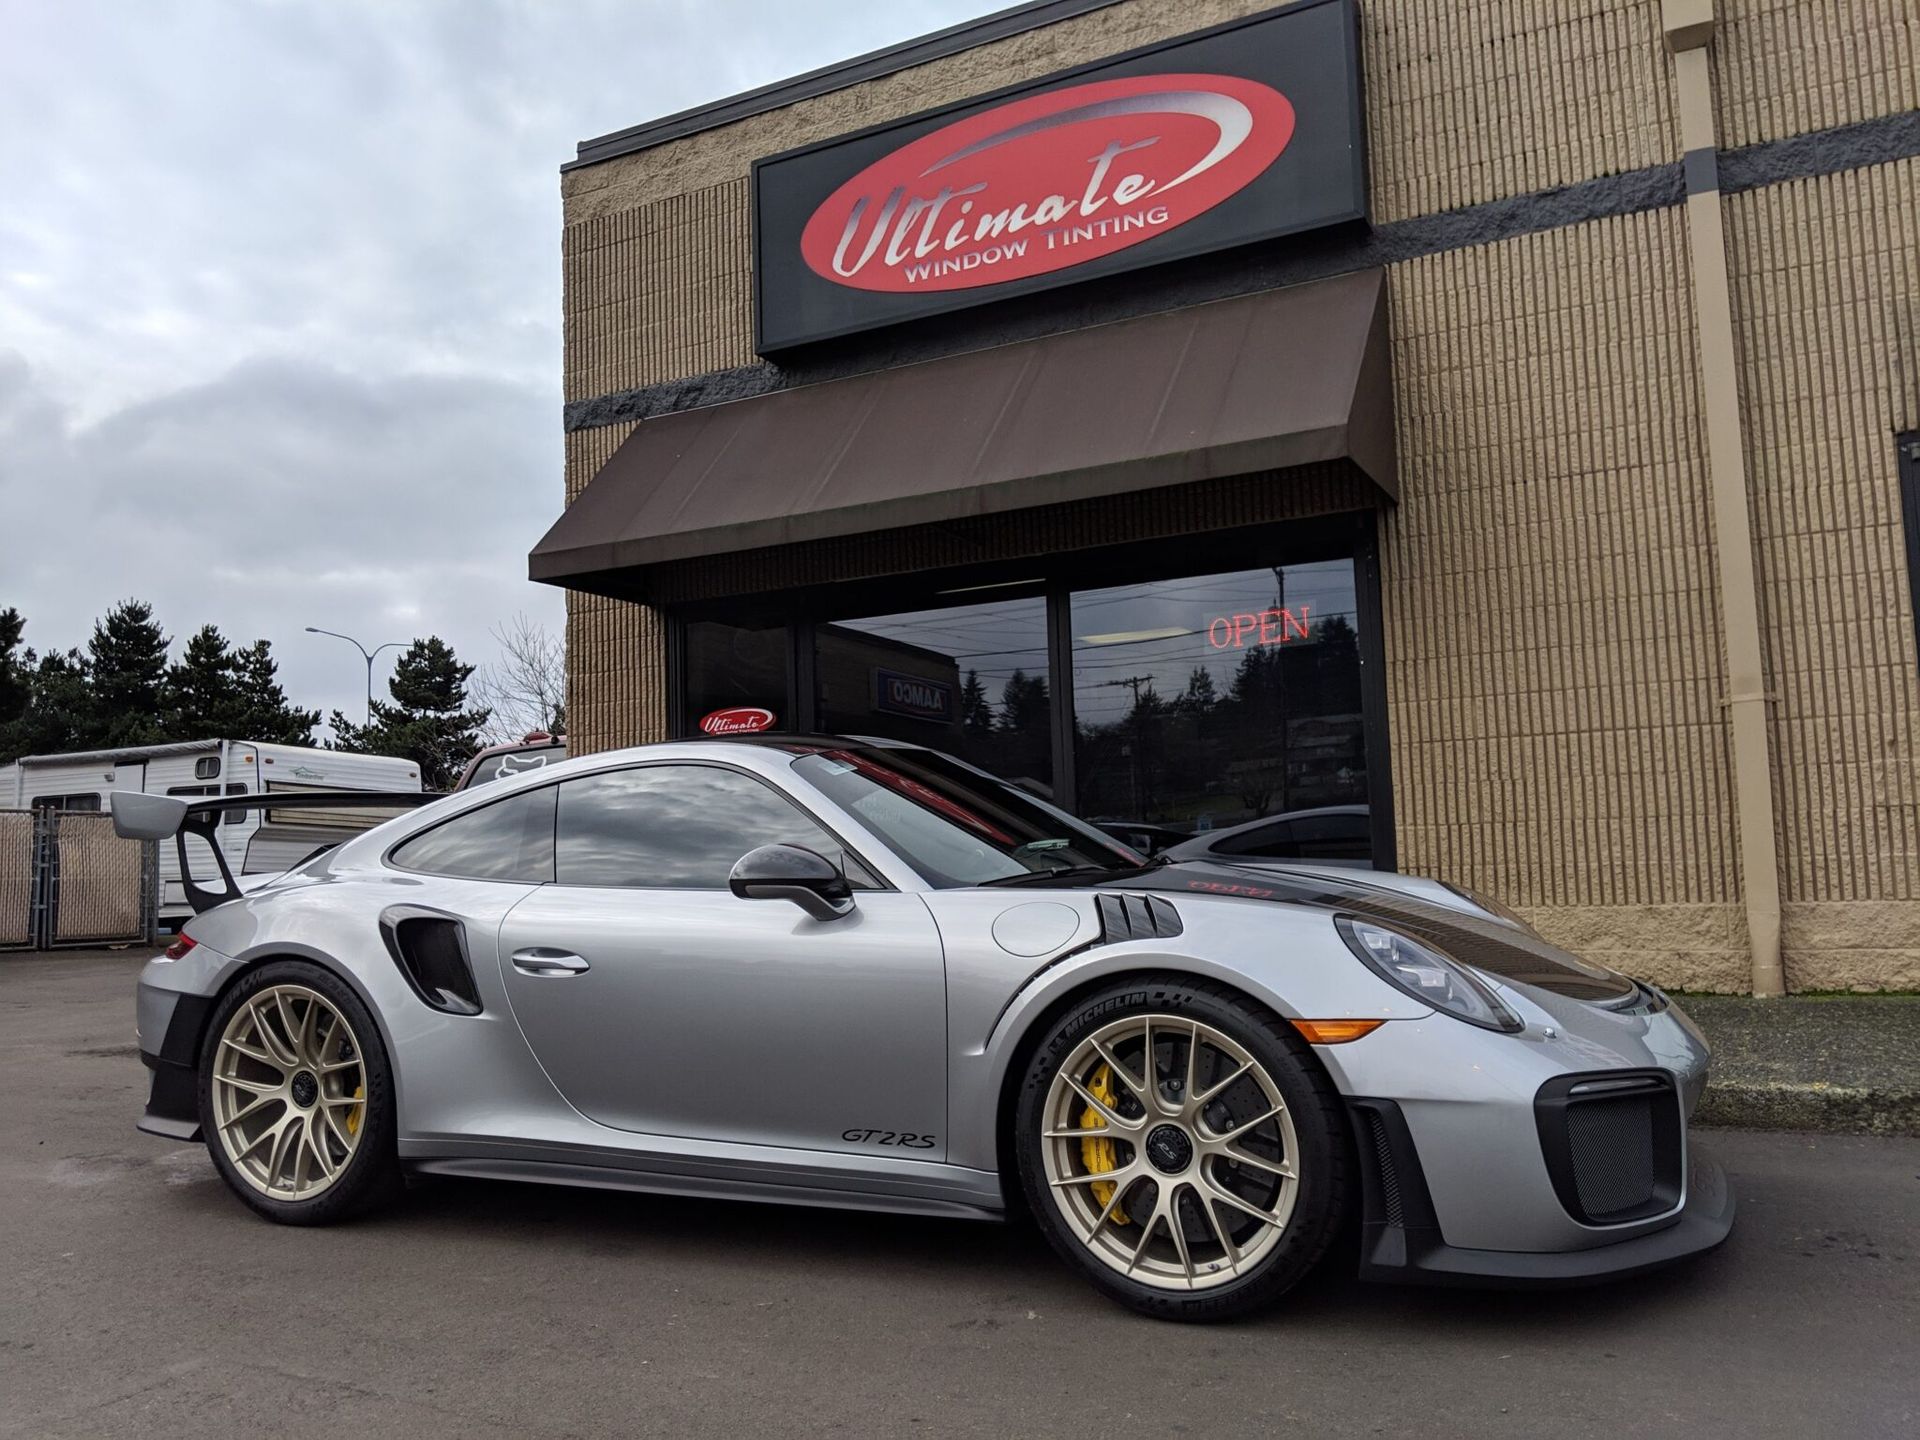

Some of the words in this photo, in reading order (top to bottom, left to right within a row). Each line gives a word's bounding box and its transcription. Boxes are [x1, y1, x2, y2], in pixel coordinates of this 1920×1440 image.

[832, 135, 1163, 278] Ultimate
[904, 243, 1029, 284] WINDOW
[1041, 205, 1170, 250] TINTING
[1207, 605, 1311, 650] OPEN
[704, 715, 760, 733] Ultimate
[1064, 991, 1148, 1038] MICHELIN
